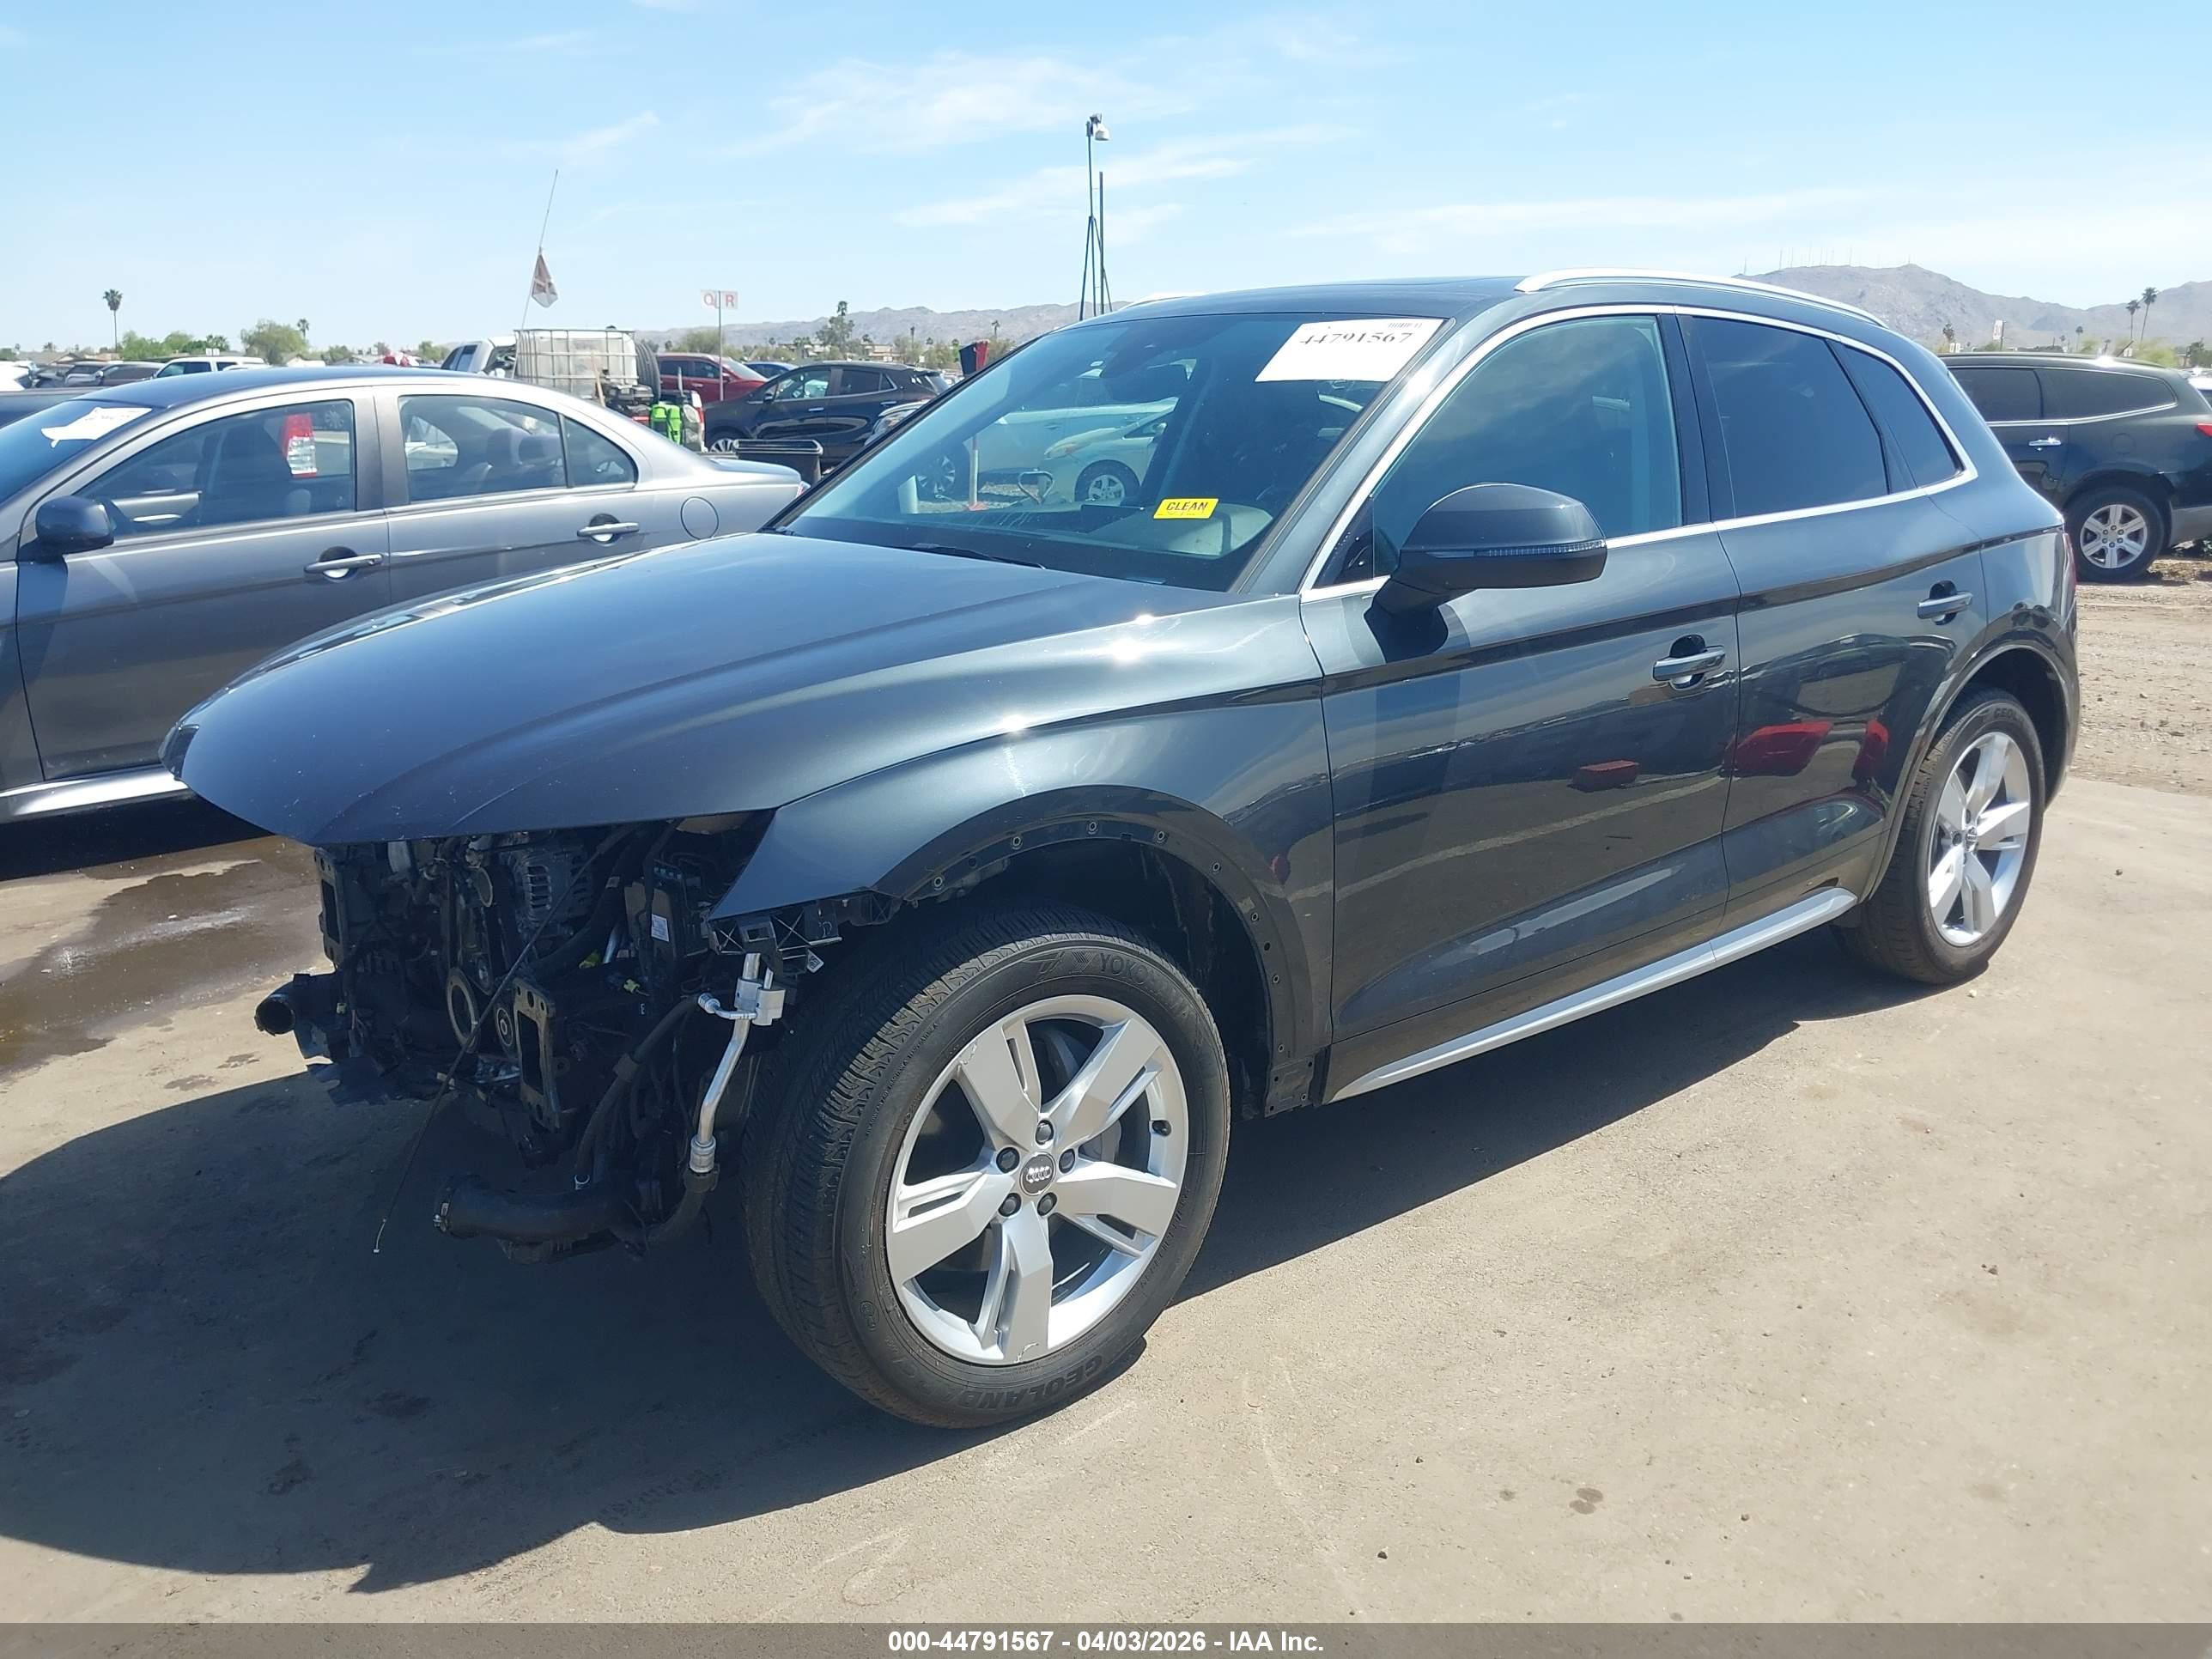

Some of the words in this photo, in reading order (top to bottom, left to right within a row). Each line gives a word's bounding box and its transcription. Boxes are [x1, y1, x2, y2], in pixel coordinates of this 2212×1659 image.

[703, 293, 715, 307] Q
[725, 294, 735, 307] R
[1299, 331, 1414, 345] 44791567
[1165, 501, 1209, 511] CLEAN
